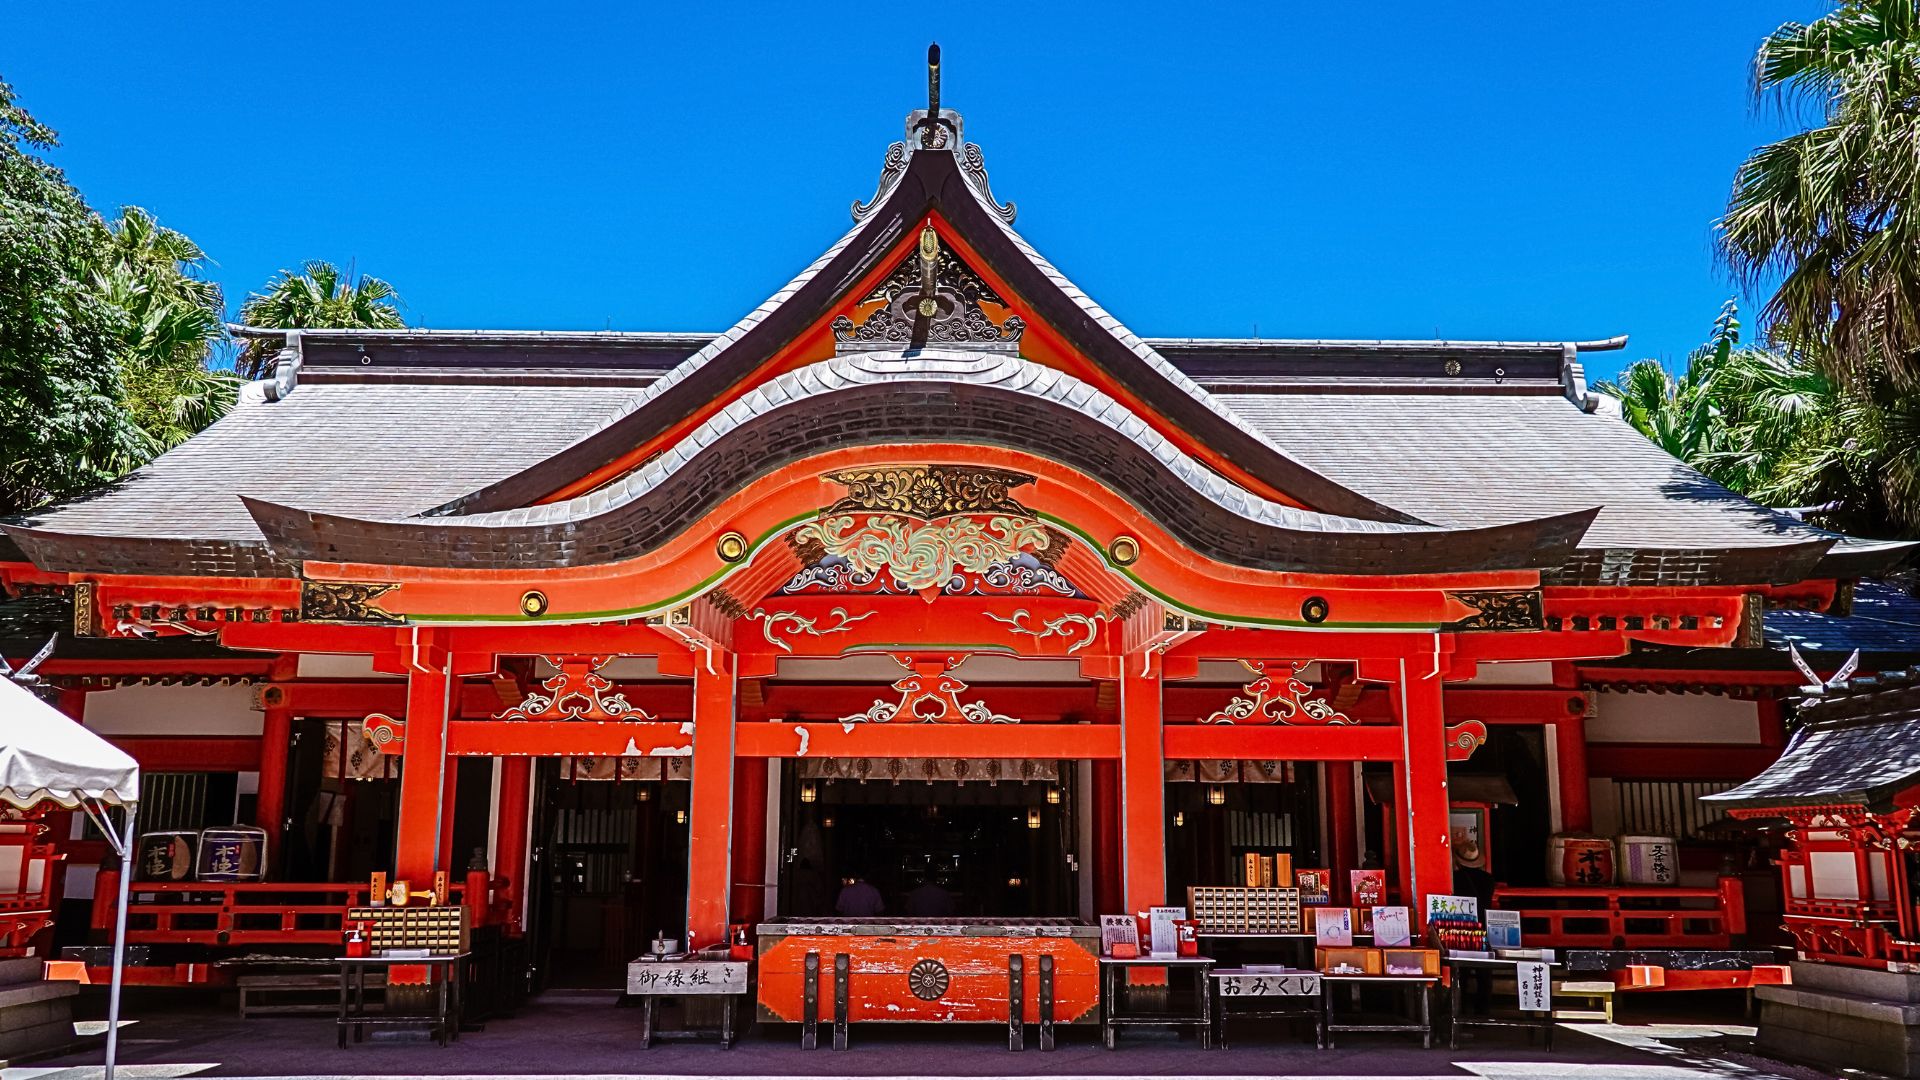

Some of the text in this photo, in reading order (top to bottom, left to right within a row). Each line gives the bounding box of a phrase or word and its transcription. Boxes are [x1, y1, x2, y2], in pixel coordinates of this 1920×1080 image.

[211, 846, 240, 874] 木挽
[1224, 976, 1314, 995] おみくじ
